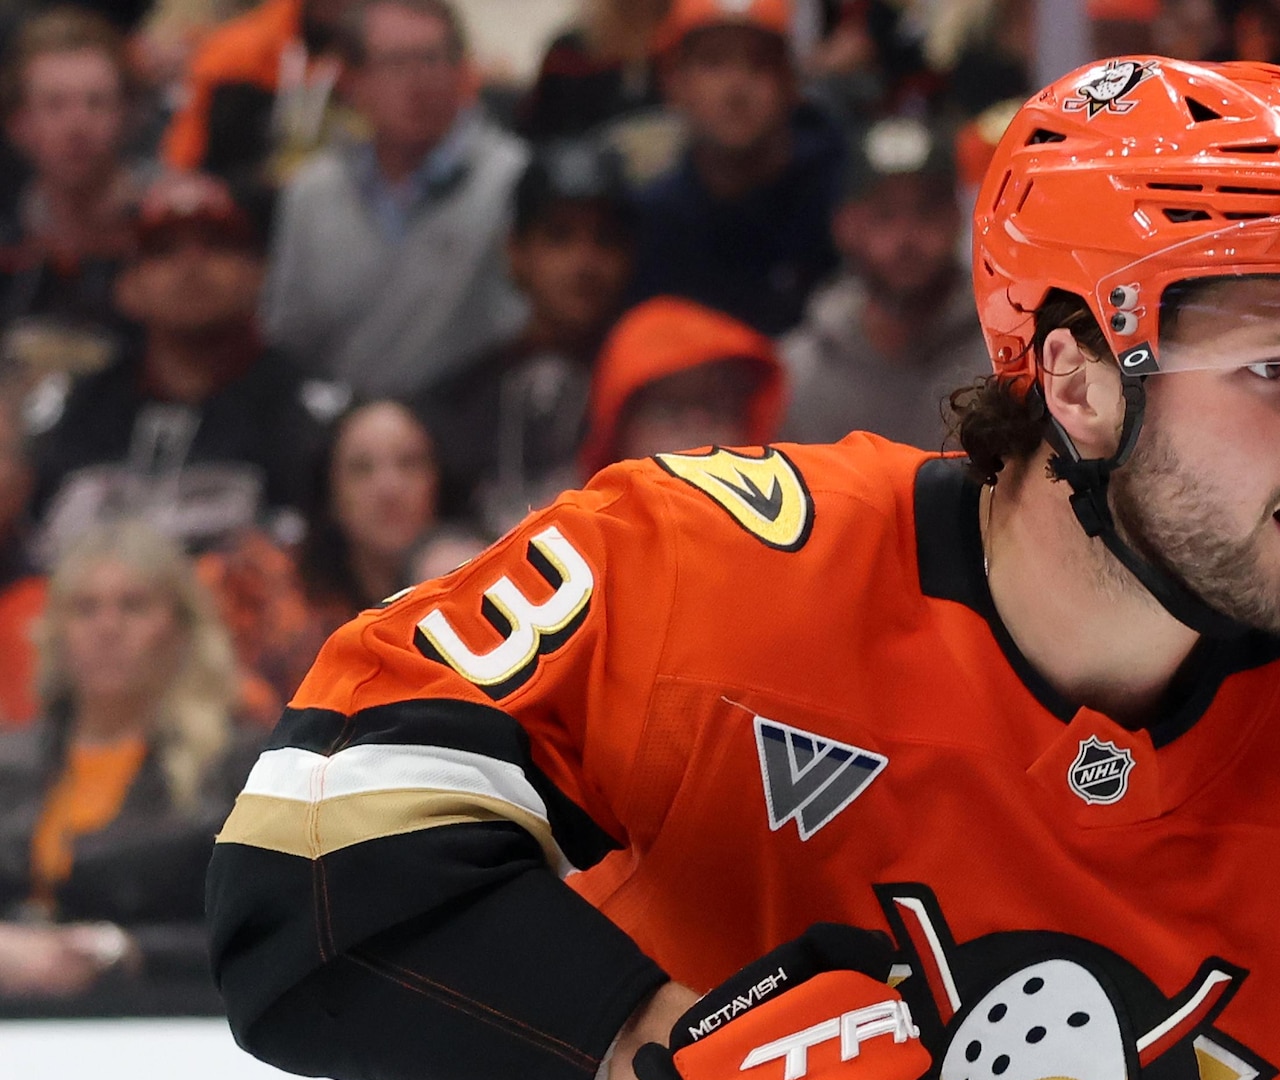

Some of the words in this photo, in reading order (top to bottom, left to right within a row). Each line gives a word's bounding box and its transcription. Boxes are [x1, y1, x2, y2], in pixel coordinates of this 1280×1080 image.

[382, 525, 596, 700] 3
[1079, 760, 1121, 784] NHL
[688, 966, 788, 1041] MCTAVISH
